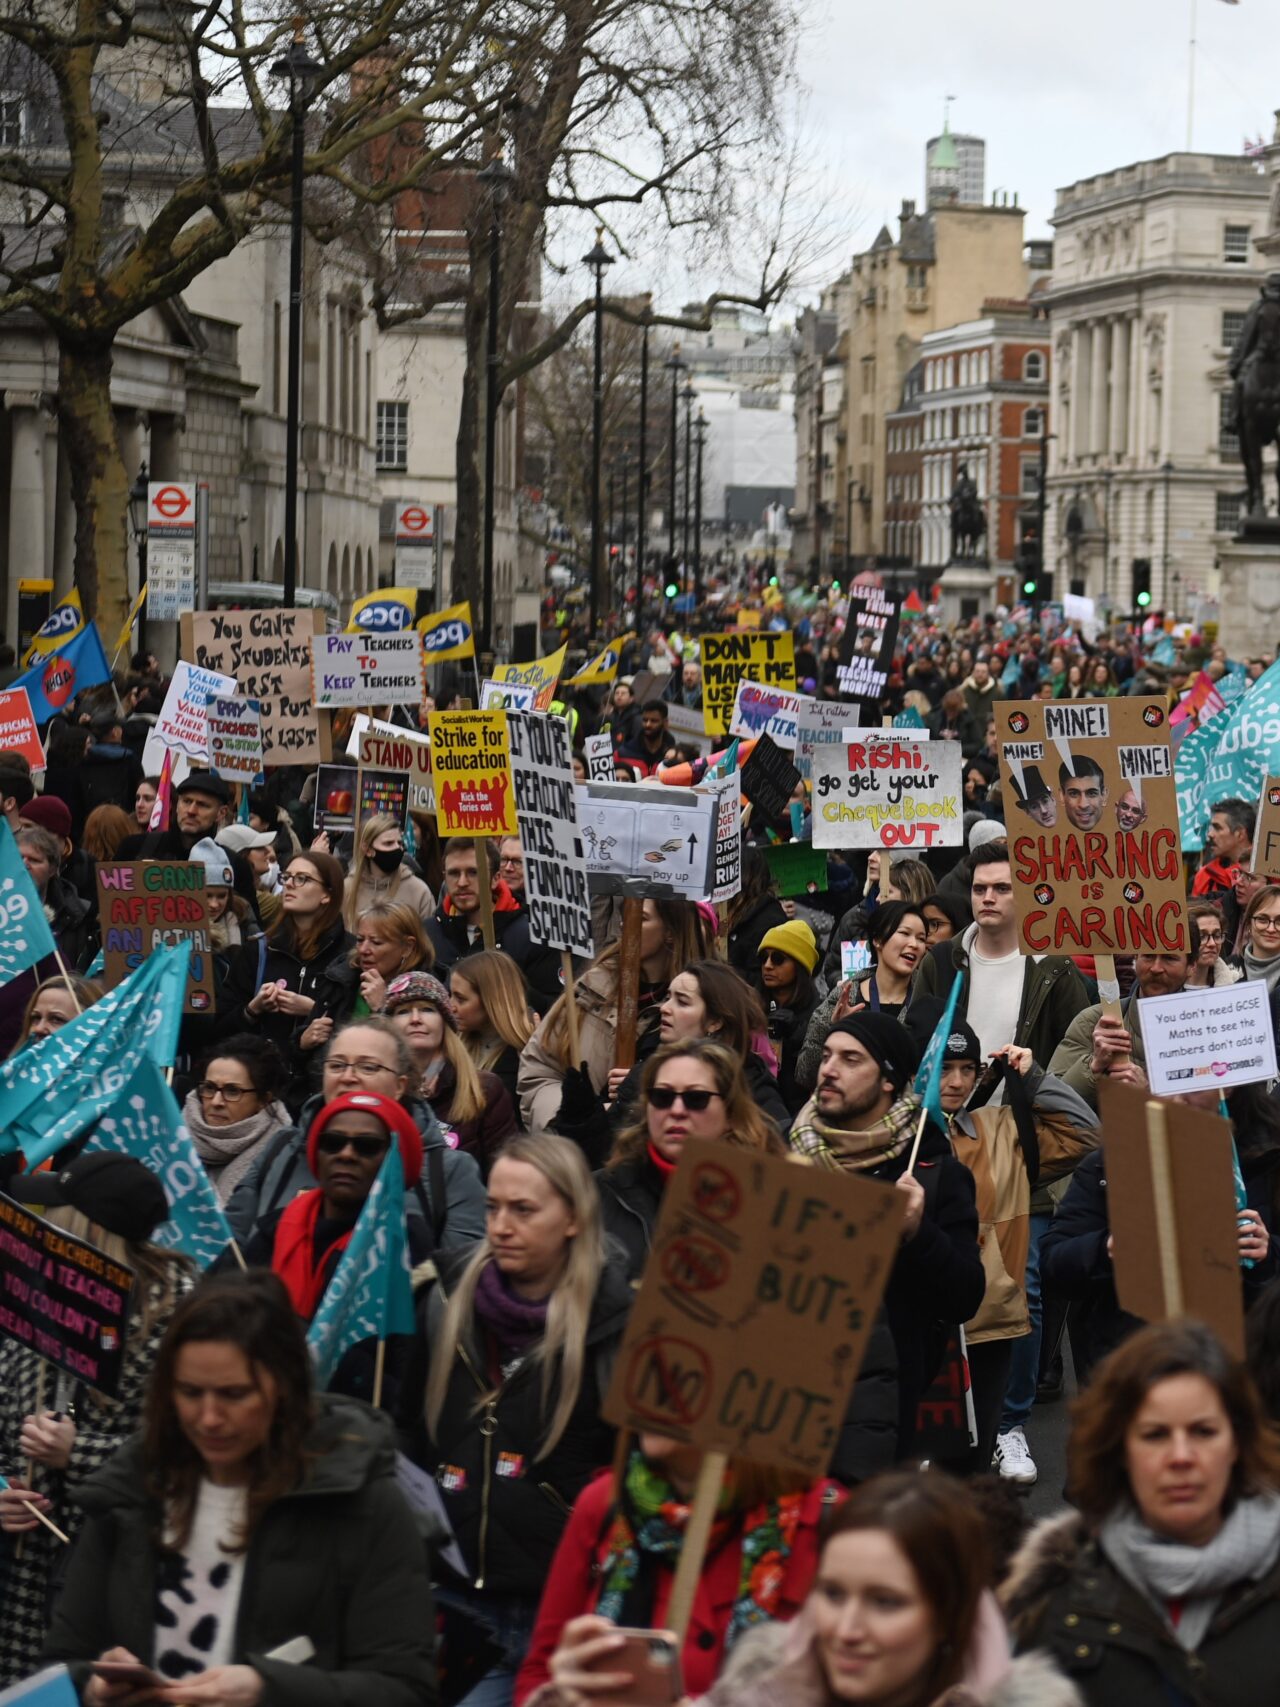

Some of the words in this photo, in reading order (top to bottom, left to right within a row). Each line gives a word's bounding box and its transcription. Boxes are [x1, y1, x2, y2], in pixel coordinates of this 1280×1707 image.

[231, 640, 310, 672] STUDENTS
[327, 636, 353, 654] PAY
[359, 635, 414, 651] TEACHERS
[704, 635, 781, 661] DON'T
[704, 664, 760, 684] MAKE
[764, 661, 794, 682] ME
[851, 655, 875, 670] PAY
[187, 667, 224, 688] VALUE
[324, 674, 356, 690] KEEP
[360, 672, 416, 689] TEACHERS
[836, 665, 887, 685] TEACHERS
[162, 720, 208, 746] TEACHERS
[175, 713, 204, 732] THEIR
[1045, 706, 1107, 737] MINE!
[434, 727, 477, 748] Strike
[482, 726, 504, 747] for
[361, 736, 414, 769] STAND
[436, 749, 507, 770] education
[1003, 742, 1043, 760] MINE!
[1121, 751, 1170, 777] MINE!
[460, 791, 475, 802] Kick
[476, 791, 489, 802] the
[514, 769, 577, 824] READING
[818, 774, 841, 796] go
[848, 770, 880, 797] get
[887, 774, 939, 803] your
[458, 802, 479, 811] Tories
[480, 803, 493, 811] out
[880, 823, 943, 847] OUT.
[585, 863, 611, 871] strike
[1013, 828, 1179, 884] SHARING
[99, 867, 135, 891] WE
[526, 857, 562, 899] FUND
[562, 864, 589, 910] OUR
[653, 871, 673, 880] pay
[675, 873, 689, 881] up
[1081, 882, 1104, 900] IS
[111, 895, 205, 925] AFFORD
[1022, 900, 1185, 951] CARING
[107, 928, 142, 952] AN
[1155, 1013, 1176, 1024] You
[1180, 1008, 1206, 1020] don't
[1209, 1003, 1234, 1016] need
[1236, 997, 1260, 1012] GCSE
[1169, 1026, 1203, 1040] Maths
[1207, 1023, 1218, 1034] to
[1221, 1022, 1238, 1031] see
[1240, 1018, 1256, 1028] the
[1159, 1046, 1205, 1060] numbers
[1208, 1040, 1234, 1052] don't
[1236, 1036, 1253, 1047] add
[44, 1231, 105, 1275] TEACHERS
[43, 1258, 54, 1280] A
[57, 1264, 122, 1315] TEACHER
[4, 1271, 29, 1302] YOU
[30, 1288, 100, 1341] COULDN'T
[34, 1328, 61, 1360] THIS
[65, 1347, 99, 1380] SIGN
